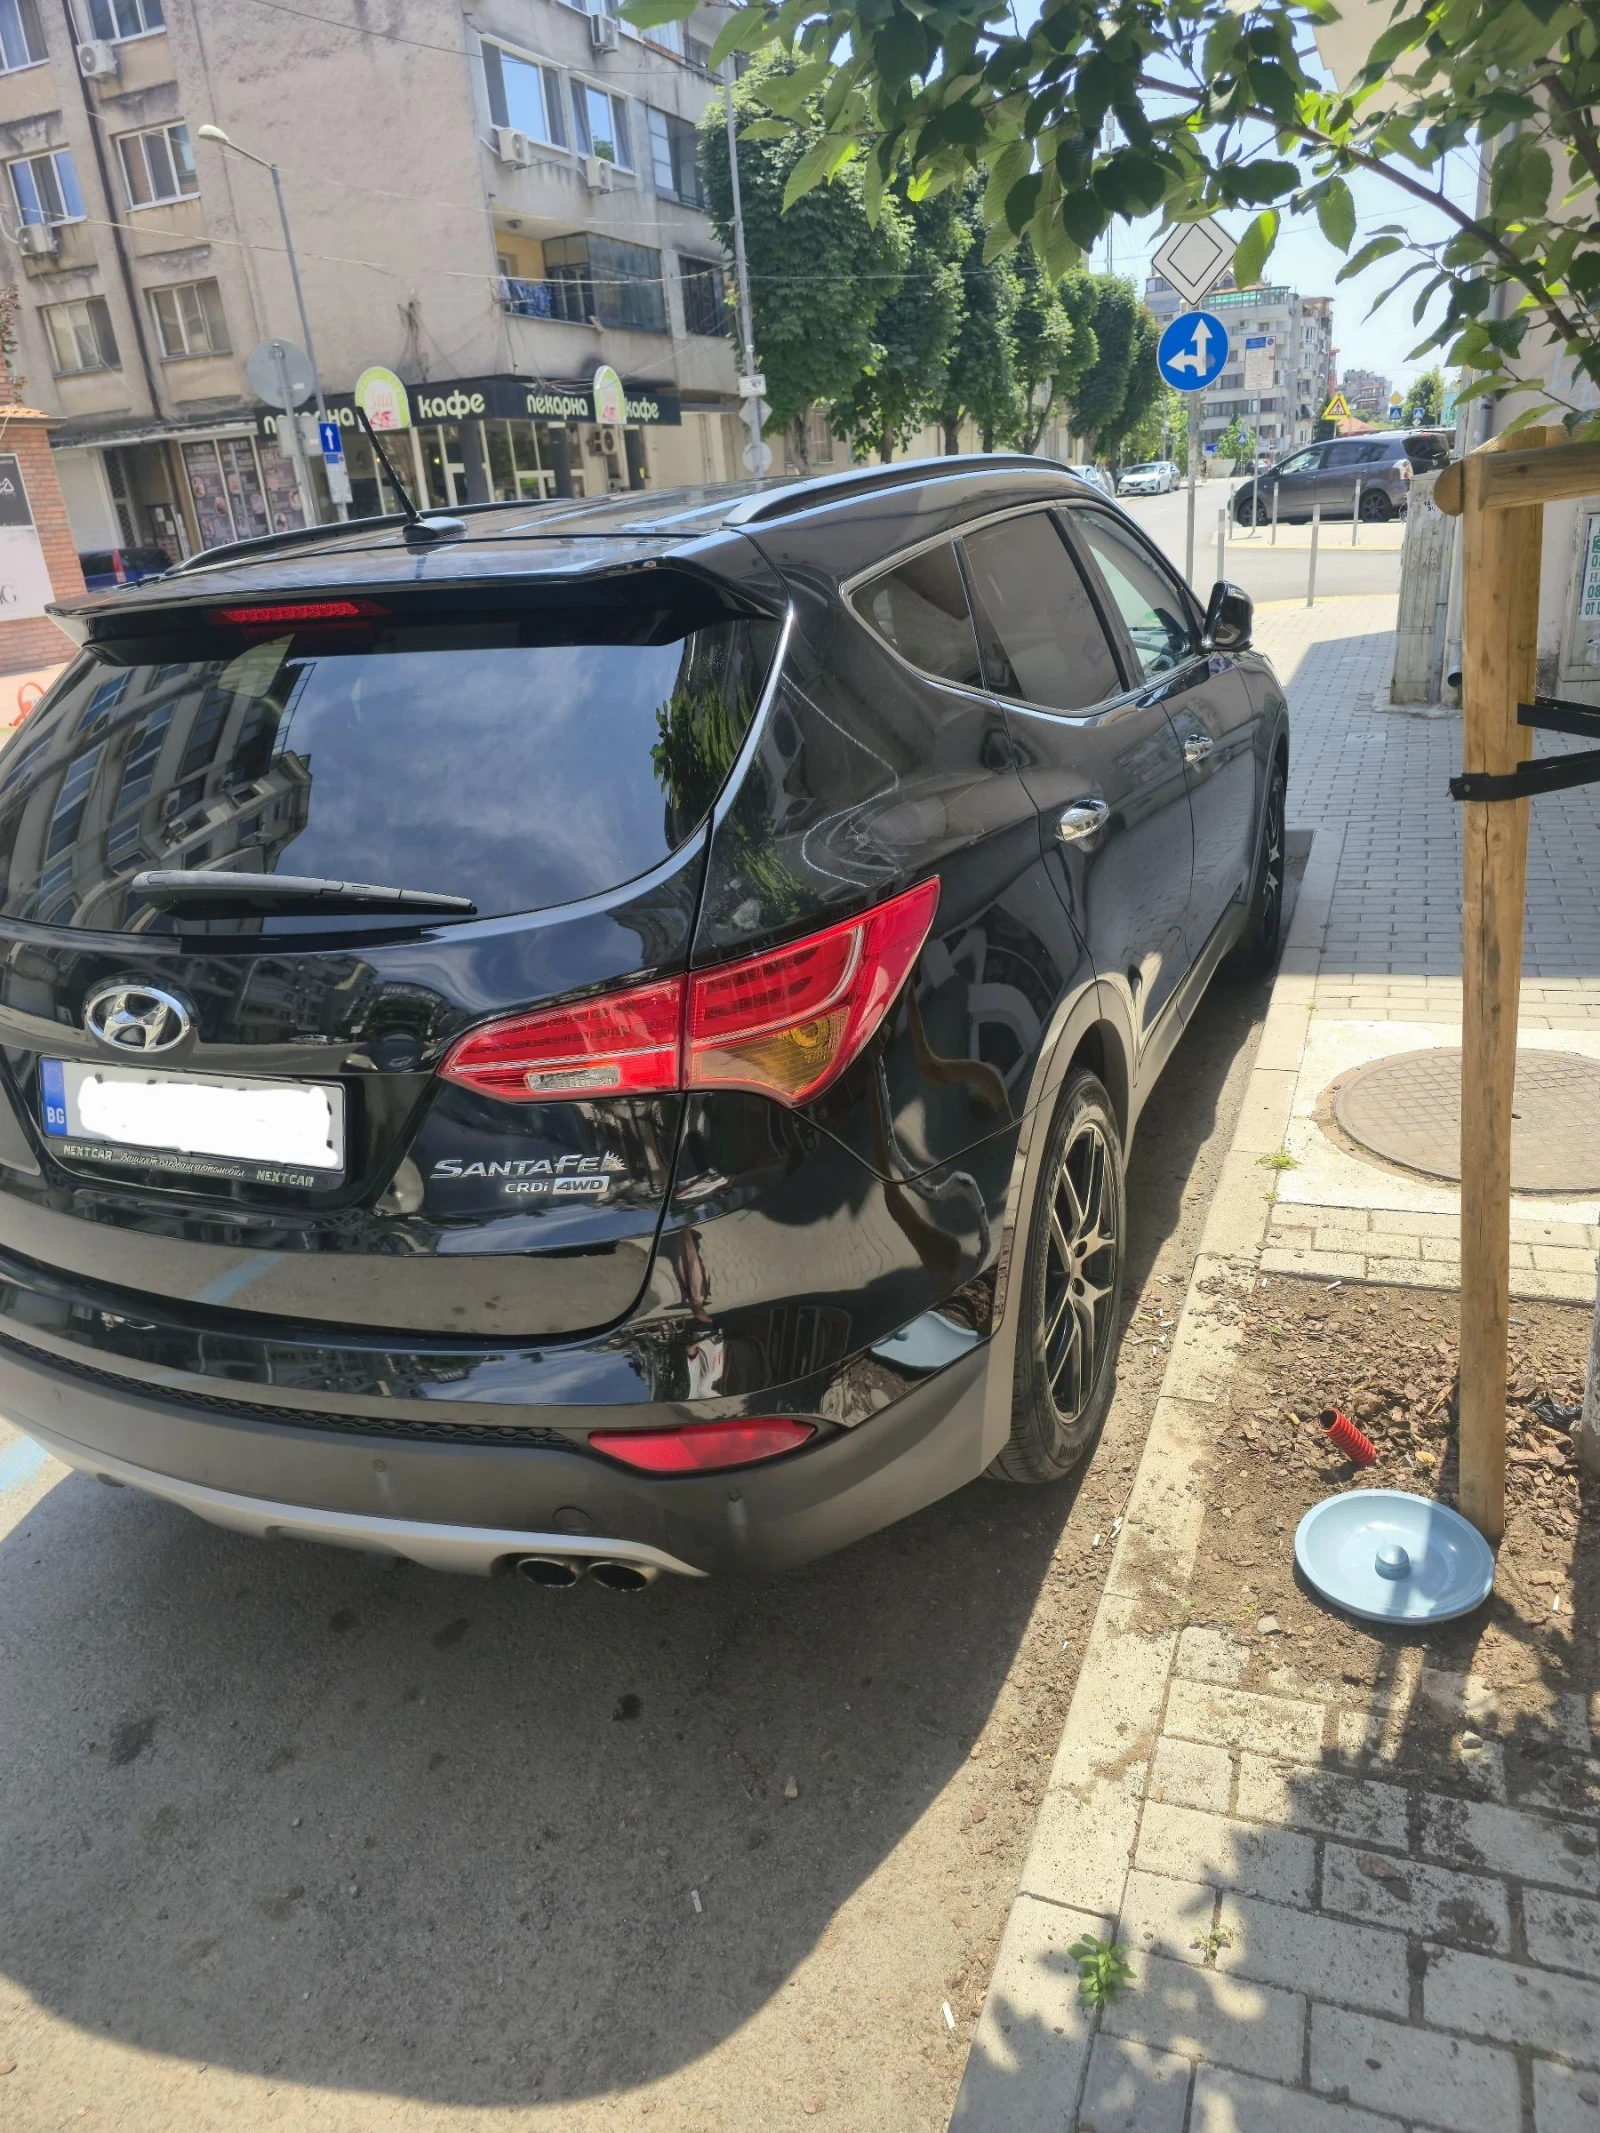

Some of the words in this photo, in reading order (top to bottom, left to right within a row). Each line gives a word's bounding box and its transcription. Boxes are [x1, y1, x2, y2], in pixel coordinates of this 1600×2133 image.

[417, 389, 486, 420] кафе
[526, 394, 589, 420] пекарна
[624, 396, 660, 422] кафе
[47, 1106, 65, 1125] BG
[556, 1179, 604, 1191] 4WD
